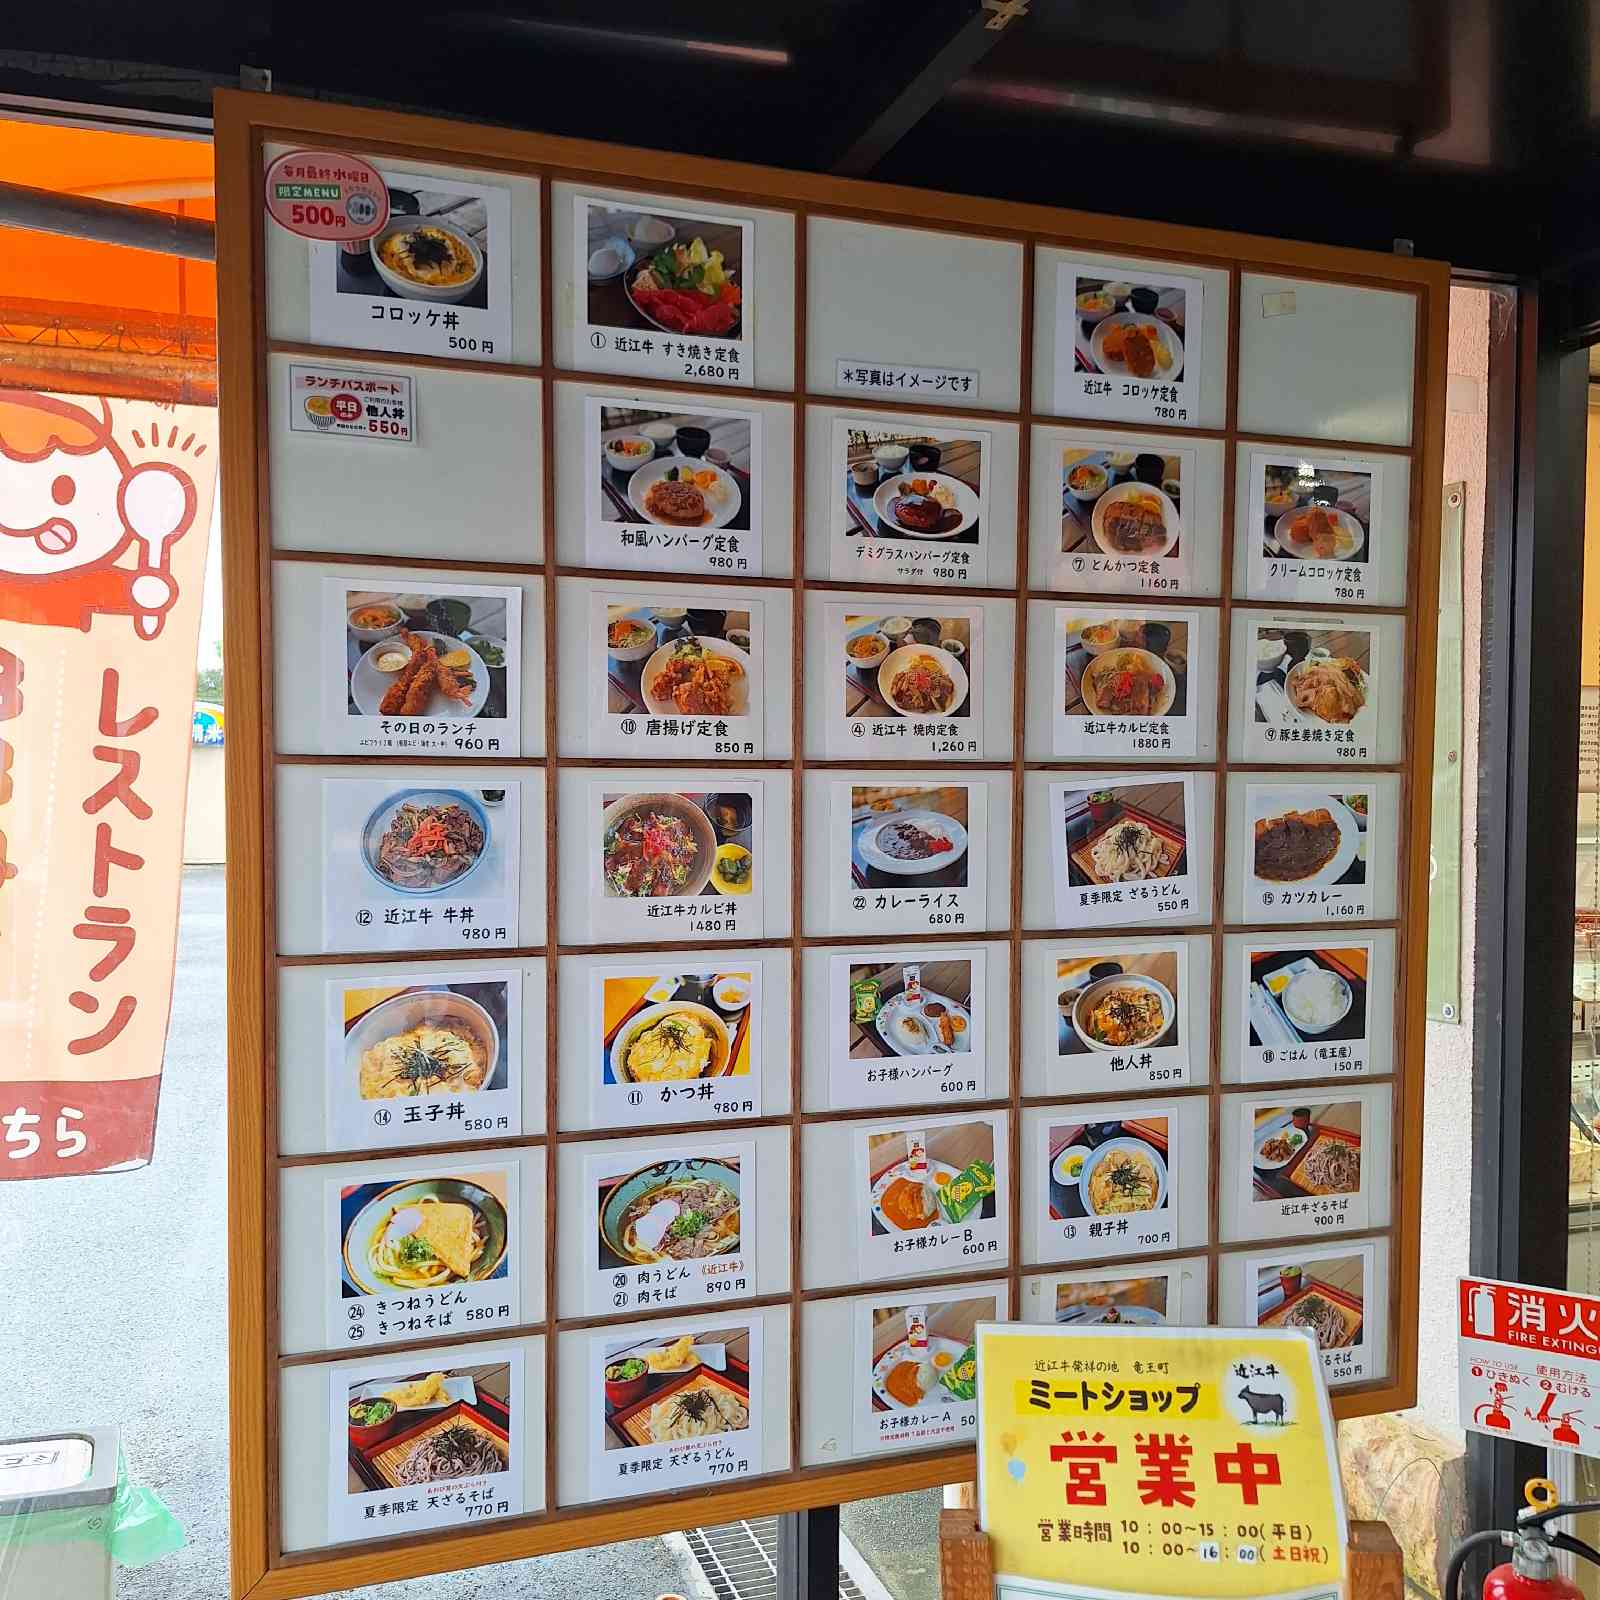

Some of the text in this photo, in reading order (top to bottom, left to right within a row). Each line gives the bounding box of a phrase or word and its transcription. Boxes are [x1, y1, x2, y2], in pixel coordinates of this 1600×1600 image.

[371, 305, 460, 330] コロッケ丼
[615, 337, 654, 354] 近江牛
[662, 341, 740, 363] すき焼き定食
[1084, 379, 1179, 403] 近江牛 コロッケ定食
[366, 405, 404, 420] 他人丼
[621, 529, 740, 553] 和風ハンバーグ定食
[856, 545, 971, 565] デミグラスハンバーグ定食
[1092, 560, 1161, 574] とんかつ定食
[1270, 563, 1362, 583] クリームコロッケ定食
[380, 720, 477, 735] その日のランチ
[646, 718, 729, 737] 唐揚げ定食
[872, 724, 907, 737] 近江牛
[913, 723, 959, 736] 焼肉定食
[1084, 722, 1169, 735] 近江牛カルビ定食
[1279, 728, 1355, 743] 豚生姜焼き定食
[67, 667, 159, 1056] レストラン
[875, 893, 959, 909] カレーライス
[1079, 884, 1180, 906] 夏季限定 ざるうどん
[1281, 891, 1343, 904] カツカレー
[384, 907, 433, 924] 近江牛
[443, 907, 475, 924] 牛丼
[647, 902, 737, 918] 近江牛カルビ丼
[1110, 1052, 1152, 1072] 他人丼
[1280, 1050, 1308, 1061] ごはん
[866, 1063, 953, 1082] お子様ハンバーグ
[660, 1082, 715, 1103] かつ丼
[403, 1102, 465, 1123] 玉子丼
[1281, 1198, 1348, 1216] 近江牛ざるそば
[1089, 1218, 1128, 1238] 親子丼
[638, 1267, 691, 1284] 肉うどん
[376, 1291, 468, 1315] きつねうどん
[638, 1286, 678, 1304] 肉そば
[377, 1311, 453, 1336] きつねそば
[1508, 1330, 1600, 1355] FIRE EXTING
[1034, 1359, 1120, 1374] 近江牛発祥の地
[1232, 1362, 1280, 1379] 近江牛
[1536, 1364, 1588, 1384] 使用方法
[1486, 1369, 1531, 1387] ひきぬく
[1029, 1379, 1201, 1414] ミートショップ
[1556, 1383, 1591, 1398] むける
[618, 1447, 735, 1476] 夏季限定 天ざるうどん
[1050, 1430, 1282, 1508] 営業中
[363, 1487, 495, 1519] 夏季限定 天ざるそば
[1037, 1519, 1112, 1543] 営業時間
